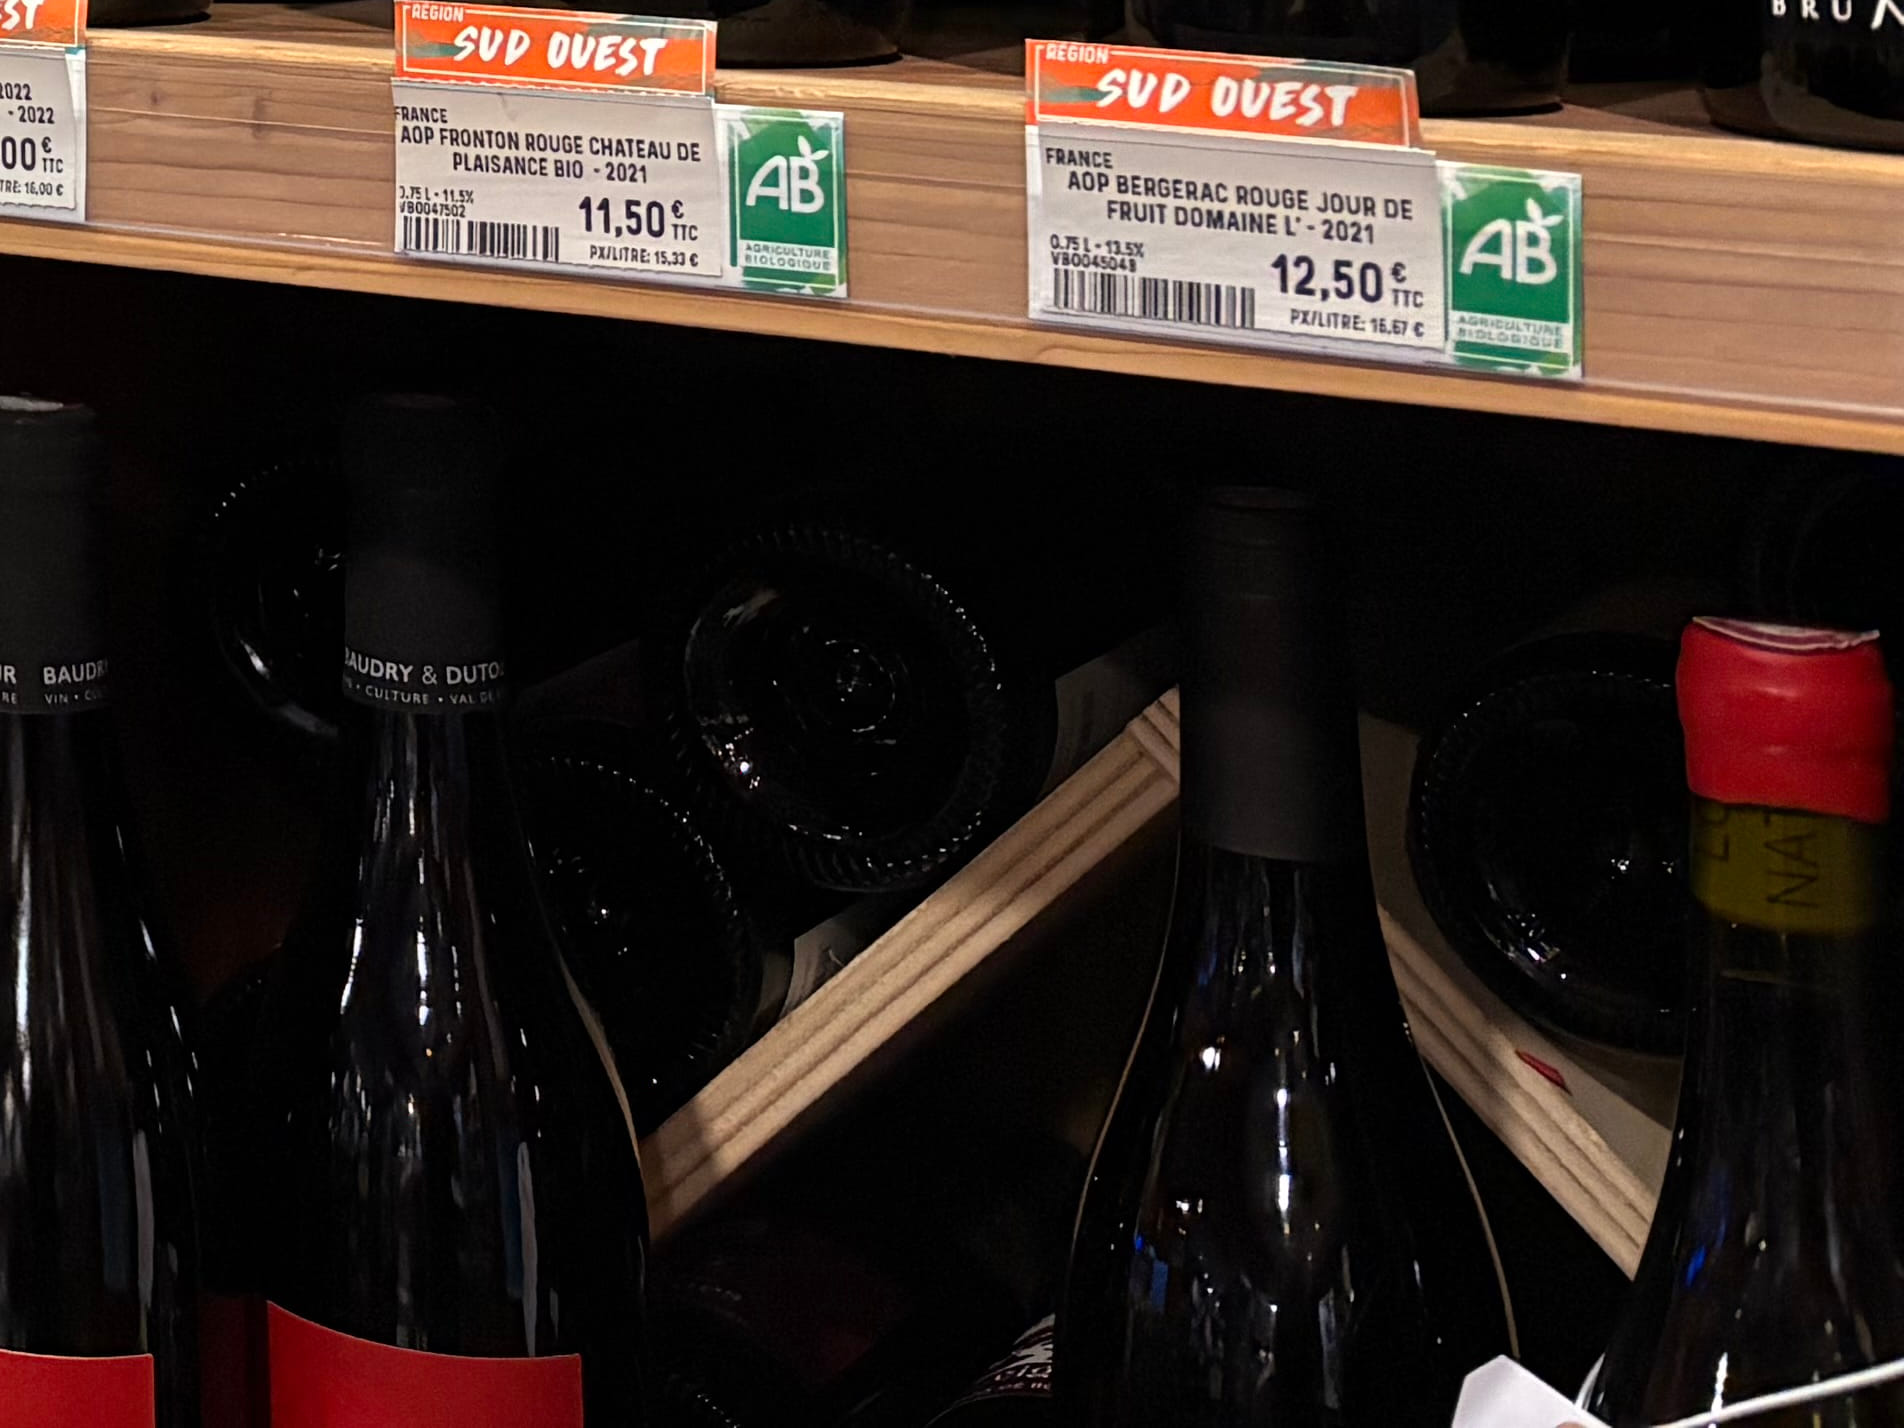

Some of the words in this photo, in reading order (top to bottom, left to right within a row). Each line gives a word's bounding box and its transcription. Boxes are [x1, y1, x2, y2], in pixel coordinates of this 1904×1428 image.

[453, 25, 530, 65] SUD
[547, 32, 667, 76] OUEST
[19, 106, 55, 124] 2022
[1097, 68, 1191, 113] SUD
[1211, 77, 1359, 128] OUEST
[401, 125, 434, 145] AOP
[440, 129, 520, 151] FRONTON
[524, 133, 583, 155] ROUGE
[589, 136, 670, 160] CHATEAU
[677, 143, 700, 162] DE
[1046, 147, 1113, 169] FRANCE
[453, 150, 549, 177] PLAISANCE
[555, 159, 584, 179] BIO
[606, 162, 648, 183] 2021
[579, 196, 664, 238] 11,50
[1068, 172, 1110, 194] AOP
[1116, 175, 1228, 204] BERGERAC
[1237, 185, 1308, 211] ROUGE
[1317, 192, 1377, 218] JOUR
[1385, 197, 1413, 220] DE
[1107, 199, 1166, 226] FRUIT
[1174, 205, 1277, 234] DOMAINE
[1321, 219, 1375, 244] 2021
[1271, 253, 1383, 304] 12,50
